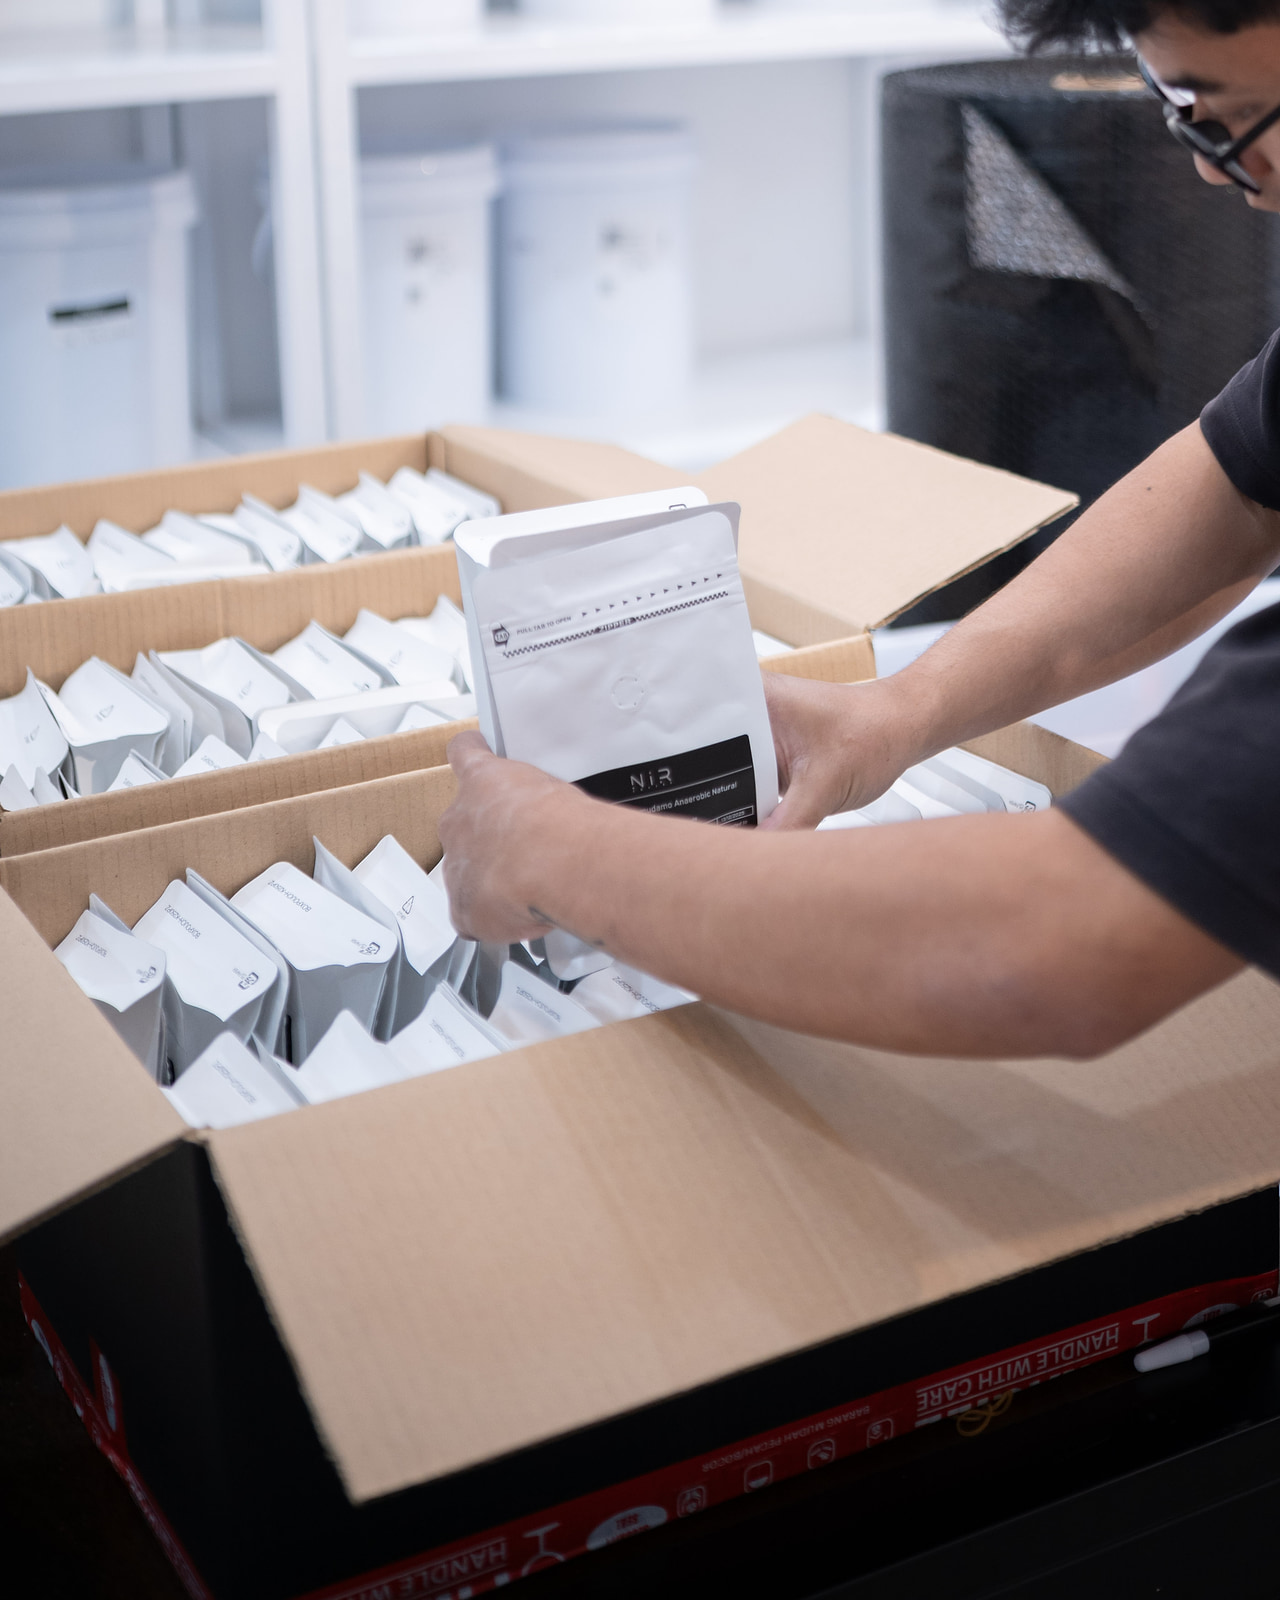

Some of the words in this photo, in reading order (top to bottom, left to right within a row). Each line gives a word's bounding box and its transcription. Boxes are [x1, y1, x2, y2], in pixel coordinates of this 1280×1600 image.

[516, 626, 532, 636] PULL
[532, 623, 546, 633] TAB
[546, 620, 555, 630] TO
[555, 616, 572, 626] OPEN
[599, 617, 632, 632] ZIPPER
[641, 800, 673, 814] udamo
[674, 791, 711, 808] Anaerobic
[711, 781, 738, 797] Natural
[1036, 1325, 1119, 1369] HANDLE
[978, 1358, 1031, 1393] WITH
[916, 1377, 972, 1410] CARE
[783, 1420, 825, 1442] MUDAH
[826, 1405, 871, 1427] BARANG
[701, 1435, 782, 1473] PECAH/BOCOR
[397, 1541, 506, 1596] HANDLE
